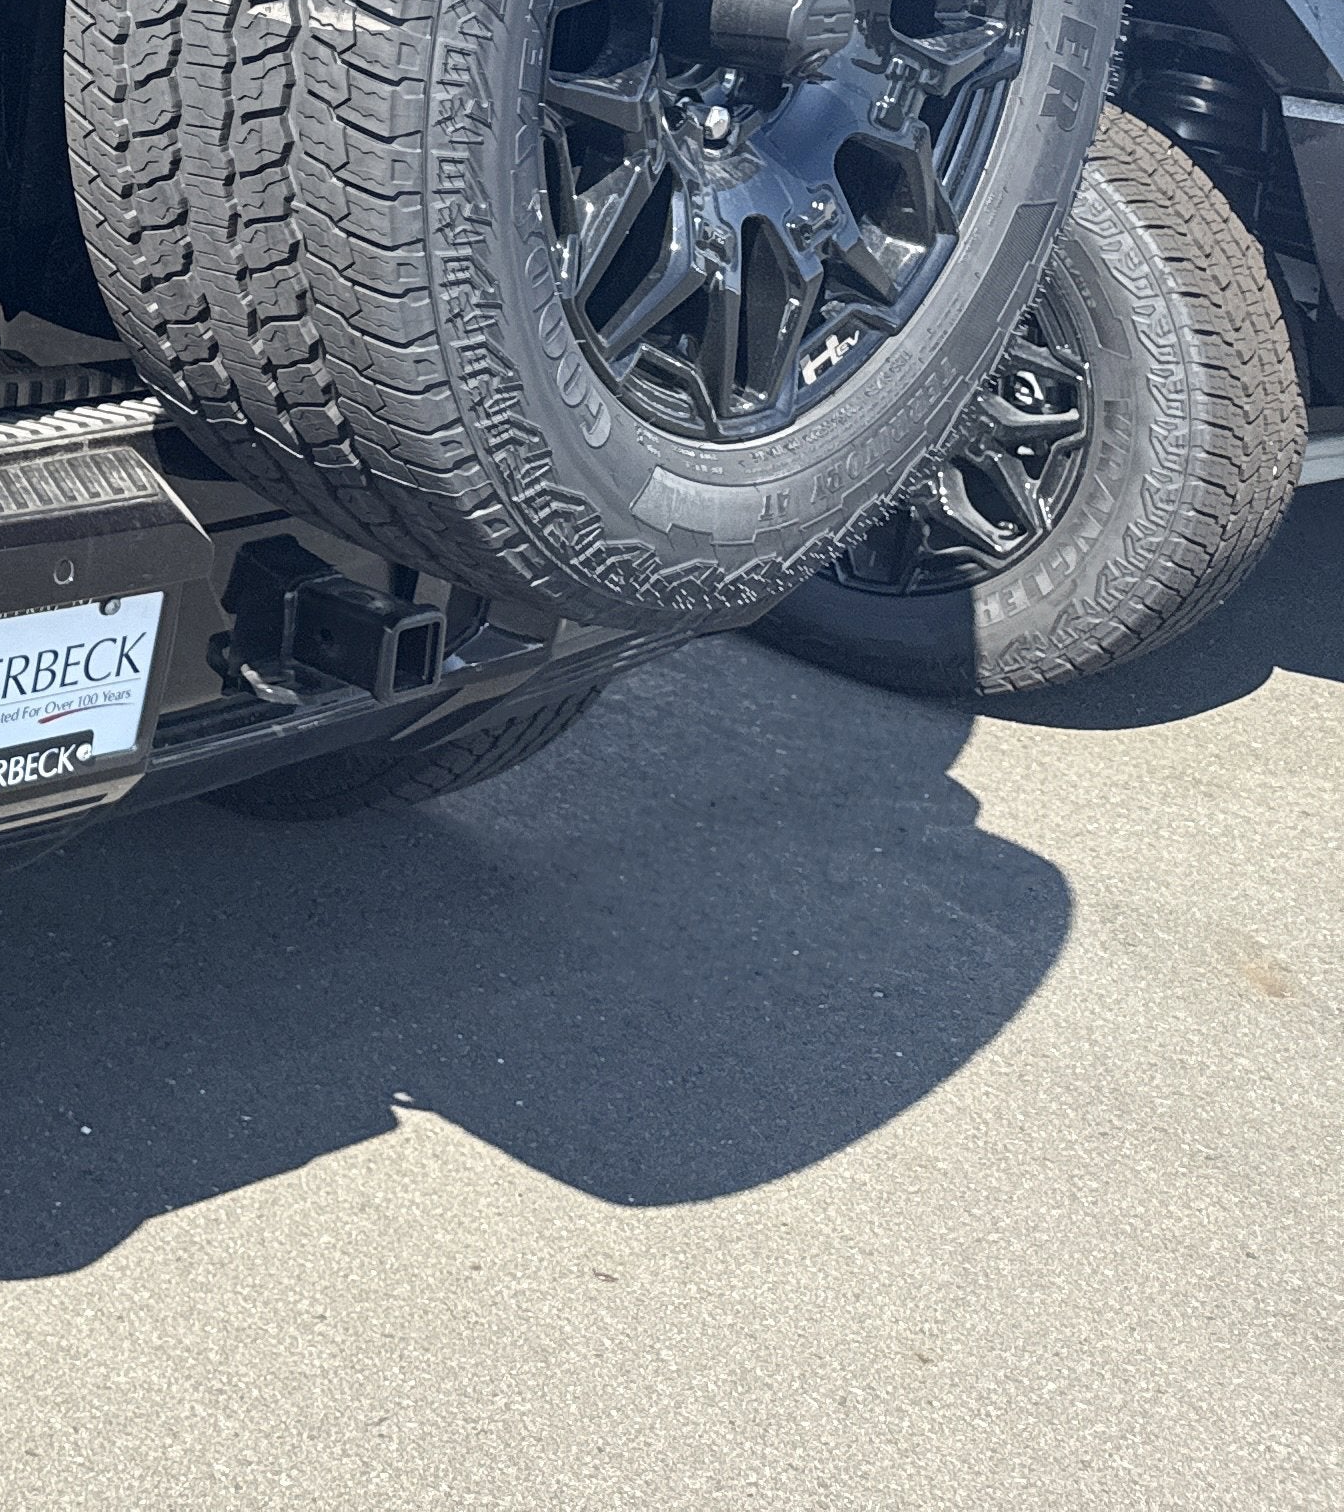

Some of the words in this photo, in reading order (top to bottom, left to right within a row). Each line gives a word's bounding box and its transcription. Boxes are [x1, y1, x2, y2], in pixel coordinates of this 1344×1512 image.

[974, 398, 1132, 628] WRANGLER
[22, 704, 42, 719] For
[44, 699, 74, 715] Over
[77, 692, 100, 709] 100
[102, 687, 132, 703] Years
